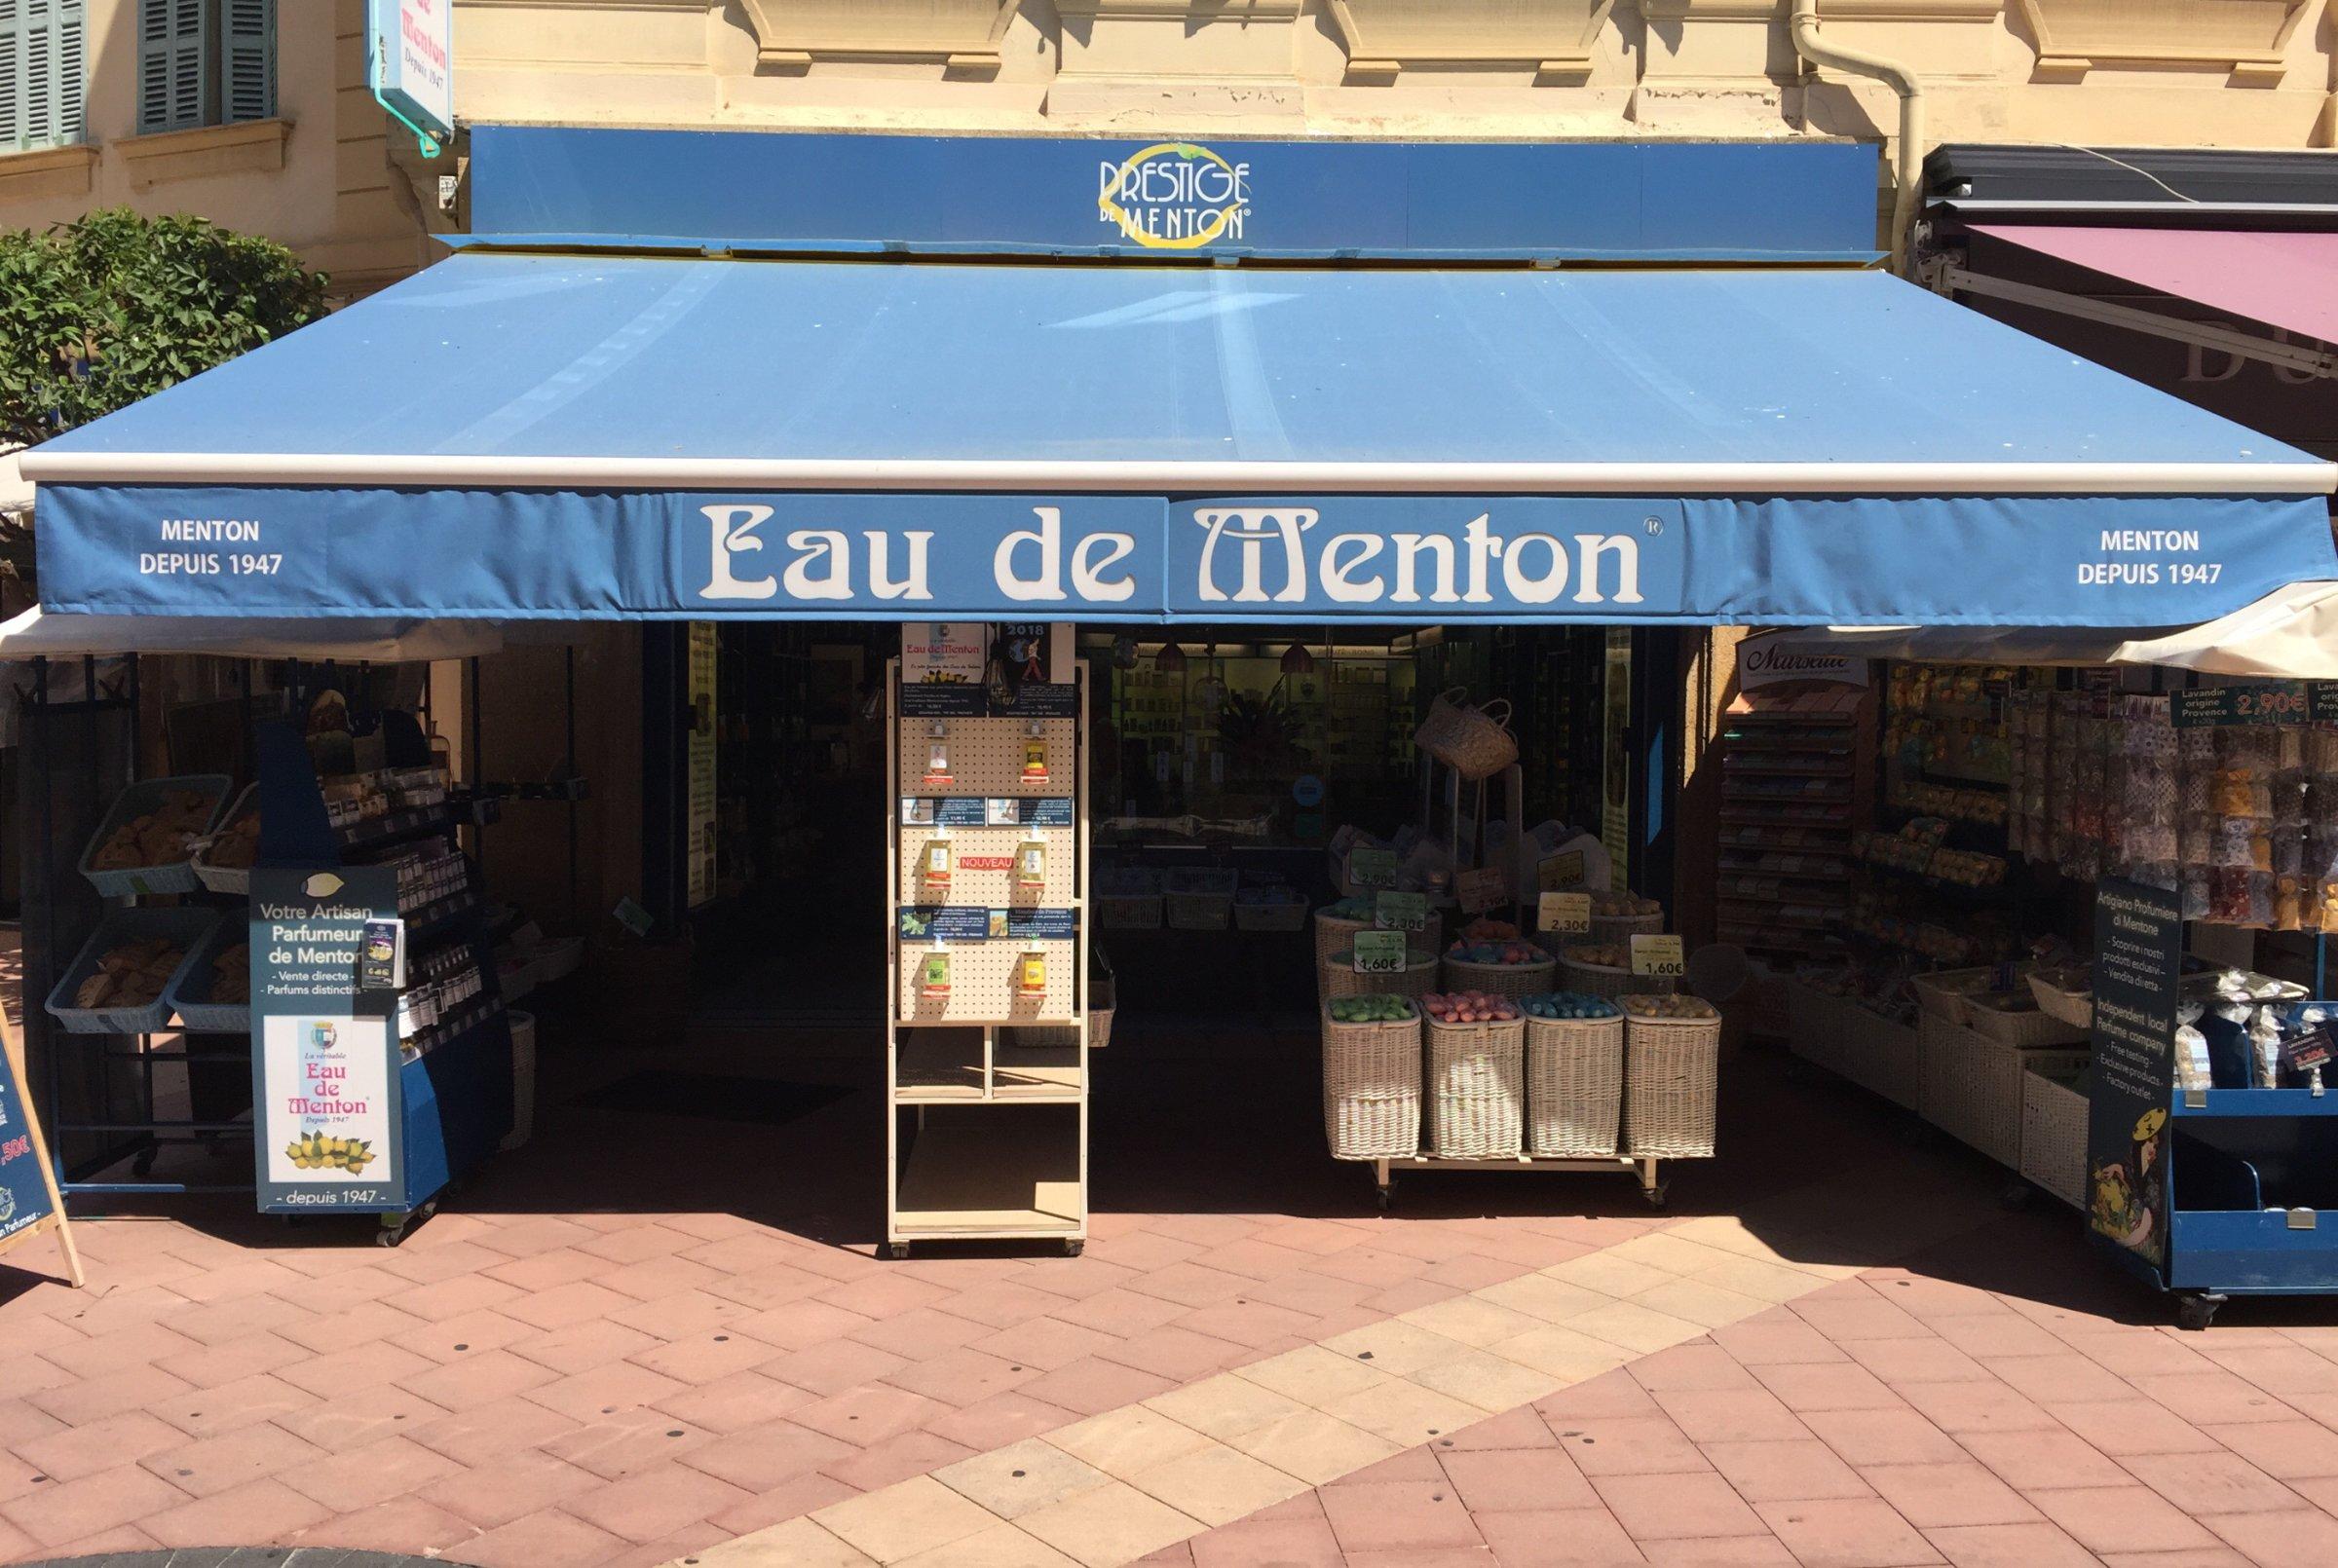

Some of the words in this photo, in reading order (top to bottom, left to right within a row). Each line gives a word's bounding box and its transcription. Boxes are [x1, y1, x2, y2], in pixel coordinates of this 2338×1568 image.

[401, 8, 446, 70] Menton
[405, 47, 427, 78] Depuis
[429, 69, 443, 91] 1947
[1100, 161, 1250, 204] PRESTIGE
[1100, 208, 1115, 222] DE
[161, 519, 259, 541] MENTON
[2101, 530, 2200, 551] MENTON
[698, 504, 935, 600] Eau
[993, 506, 1136, 602] de
[139, 553, 220, 575] DEPUIS
[228, 554, 283, 575] 1947
[2078, 563, 2160, 584] DEPUIS
[2168, 564, 2222, 584] 1947
[1006, 625, 1045, 636] 2018
[907, 644, 925, 653] Eau
[927, 644, 940, 653] de
[940, 644, 980, 654] Menton
[2182, 688, 2226, 698] Lavandin
[2185, 697, 2220, 709] origine
[2237, 692, 2306, 716] 2,90€
[2182, 709, 2228, 718] Provence
[962, 858, 1013, 868] NOUVEAU
[260, 904, 306, 919] Votre
[311, 904, 373, 919] Artisan
[2097, 891, 2132, 911] Artigiano
[2133, 899, 2178, 921] Profumiere
[1551, 919, 1589, 931] 2,30€
[2124, 915, 2159, 936] Mentone
[272, 925, 363, 942] Parfumeur
[269, 947, 292, 963] de
[1360, 958, 1397, 971] 1,60€
[1645, 963, 1683, 974] 1,60€
[279, 971, 309, 981] Vente
[312, 971, 349, 981] directe
[267, 985, 309, 994] Parfums
[312, 984, 361, 994] distinctifs
[2097, 997, 2145, 1026] Independent
[2148, 1014, 2168, 1032] local
[2096, 1016, 2127, 1038] Perfume
[2129, 1032, 2166, 1056] company
[306, 1063, 346, 1079] Eau
[315, 1081, 340, 1097] de
[288, 1098, 367, 1114] Menton
[286, 1191, 337, 1206] depuis
[342, 1190, 377, 1204] 1947
